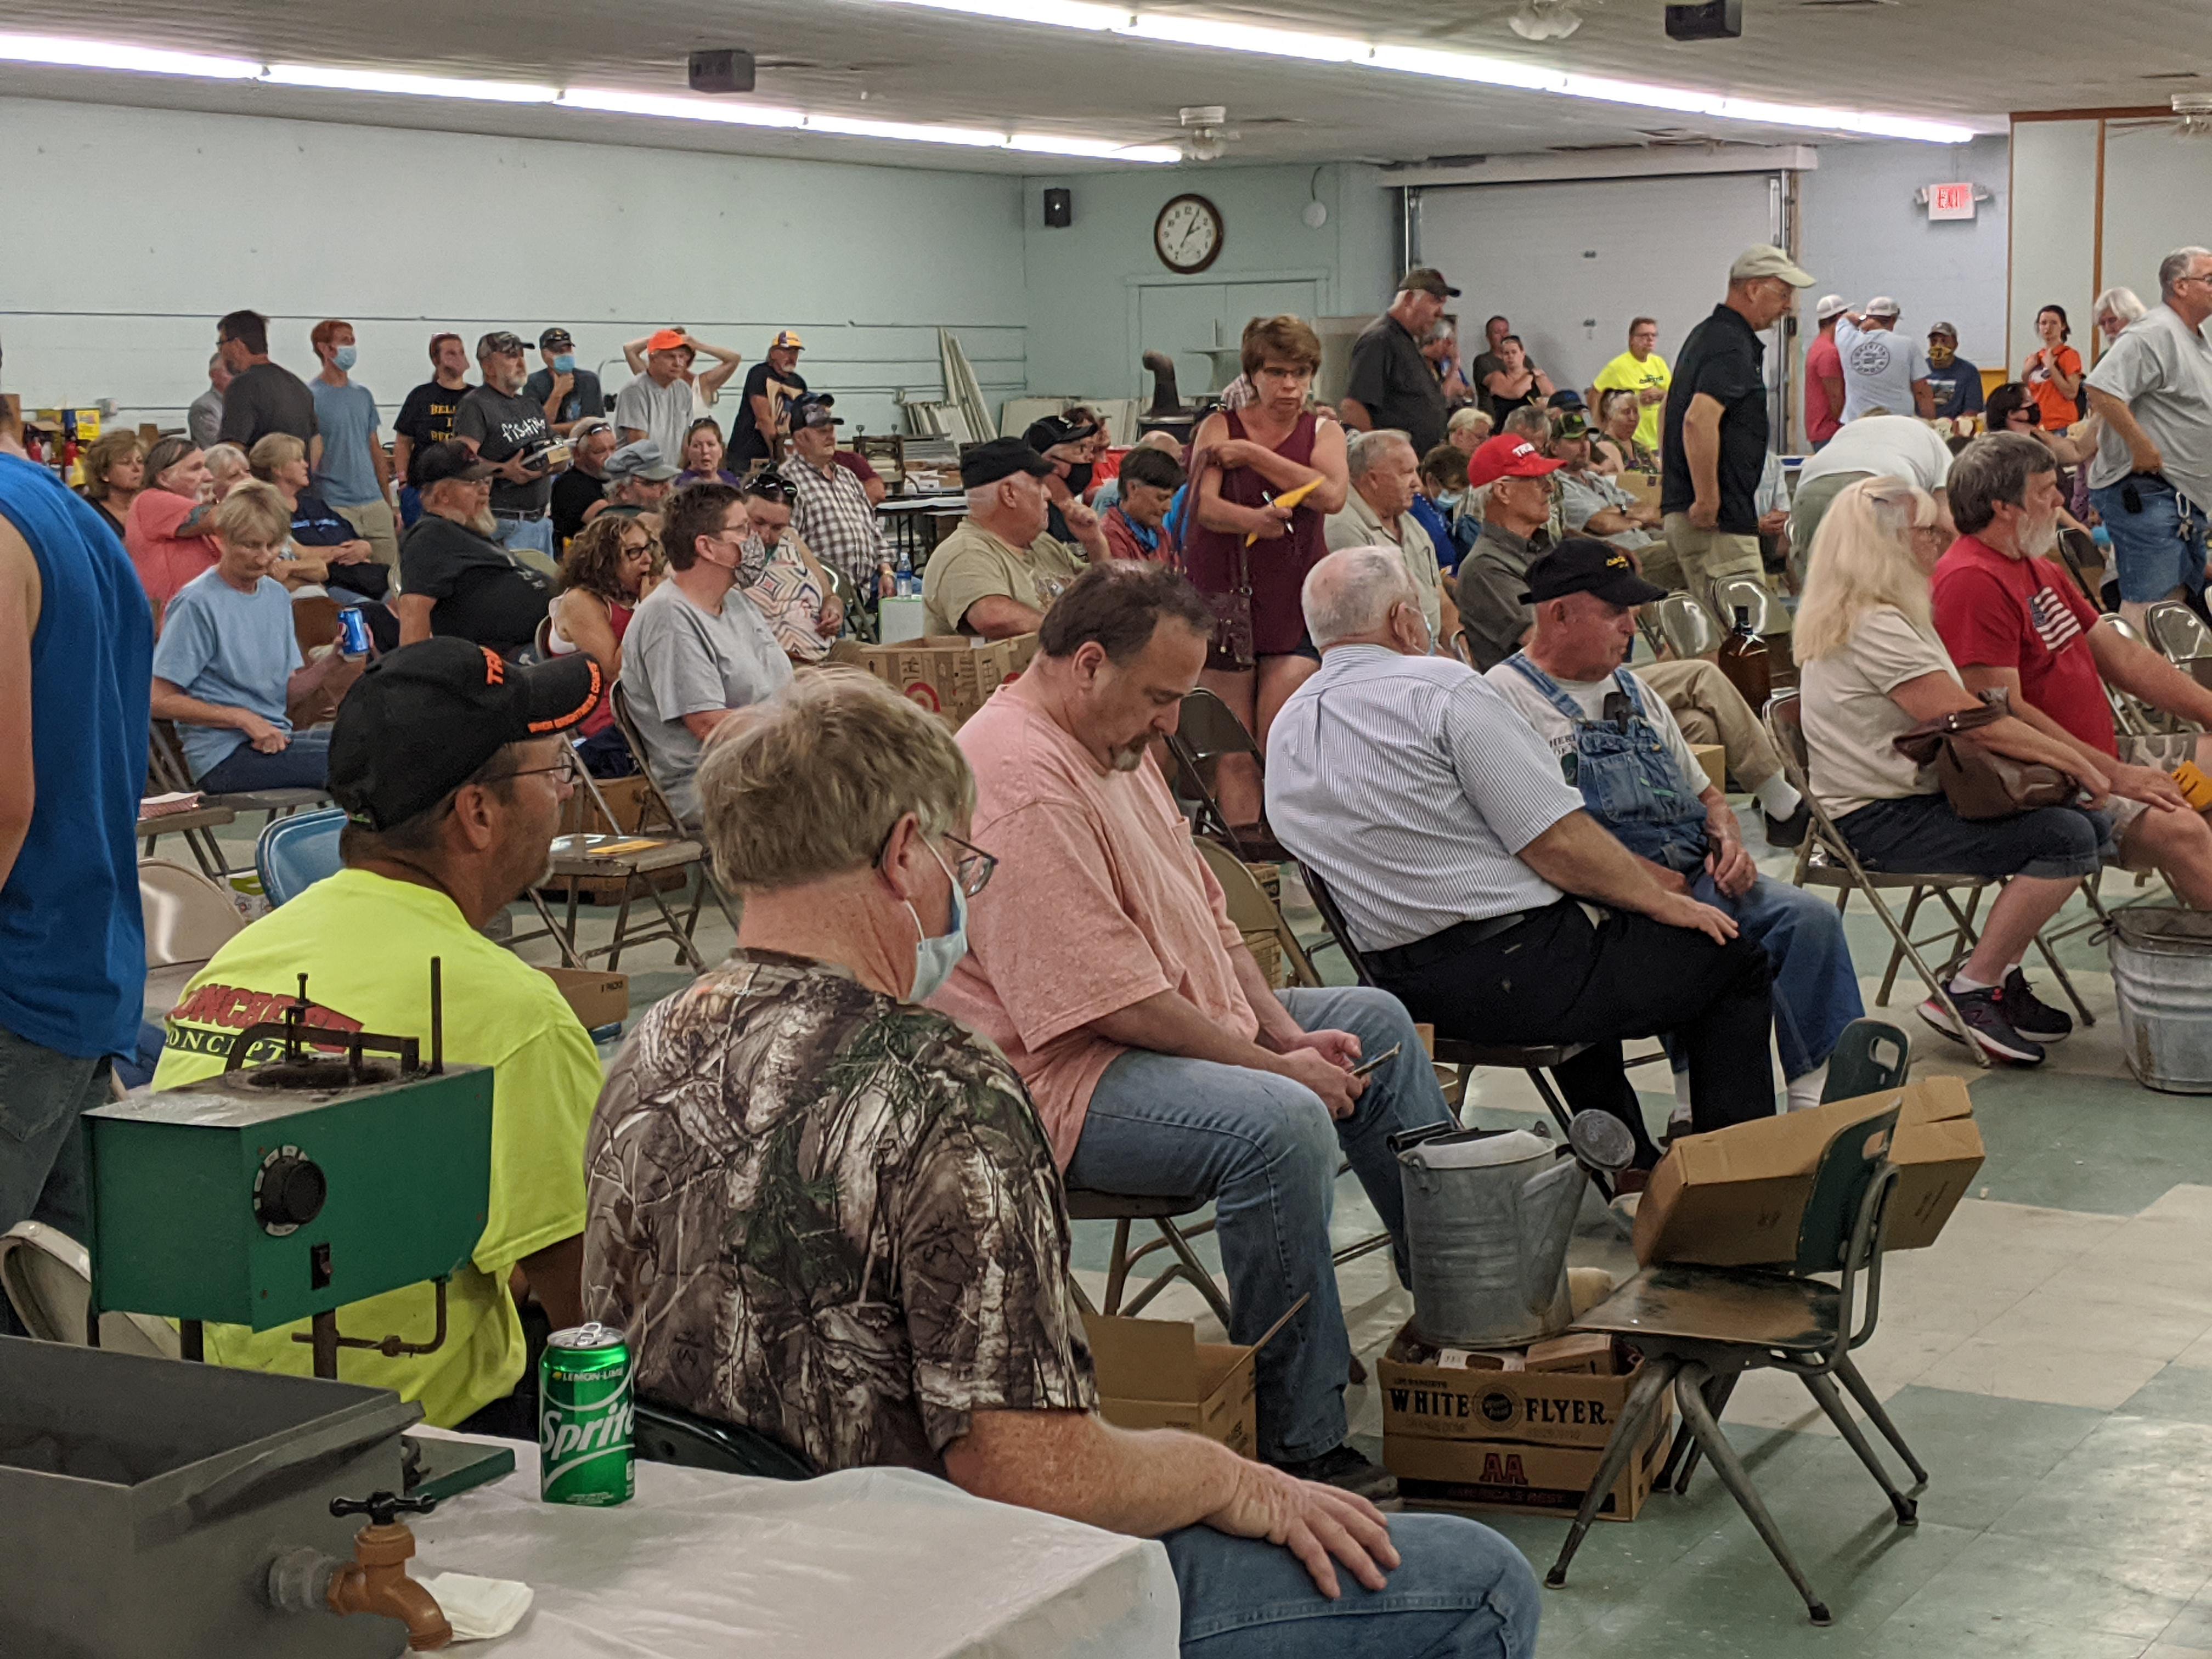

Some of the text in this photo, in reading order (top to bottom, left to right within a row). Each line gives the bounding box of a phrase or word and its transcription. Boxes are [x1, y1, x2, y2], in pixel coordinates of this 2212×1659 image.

[1390, 1388, 1470, 1418] WHITE
[1525, 1398, 1607, 1425] FLYER
[1479, 1452, 1529, 1486] AA
